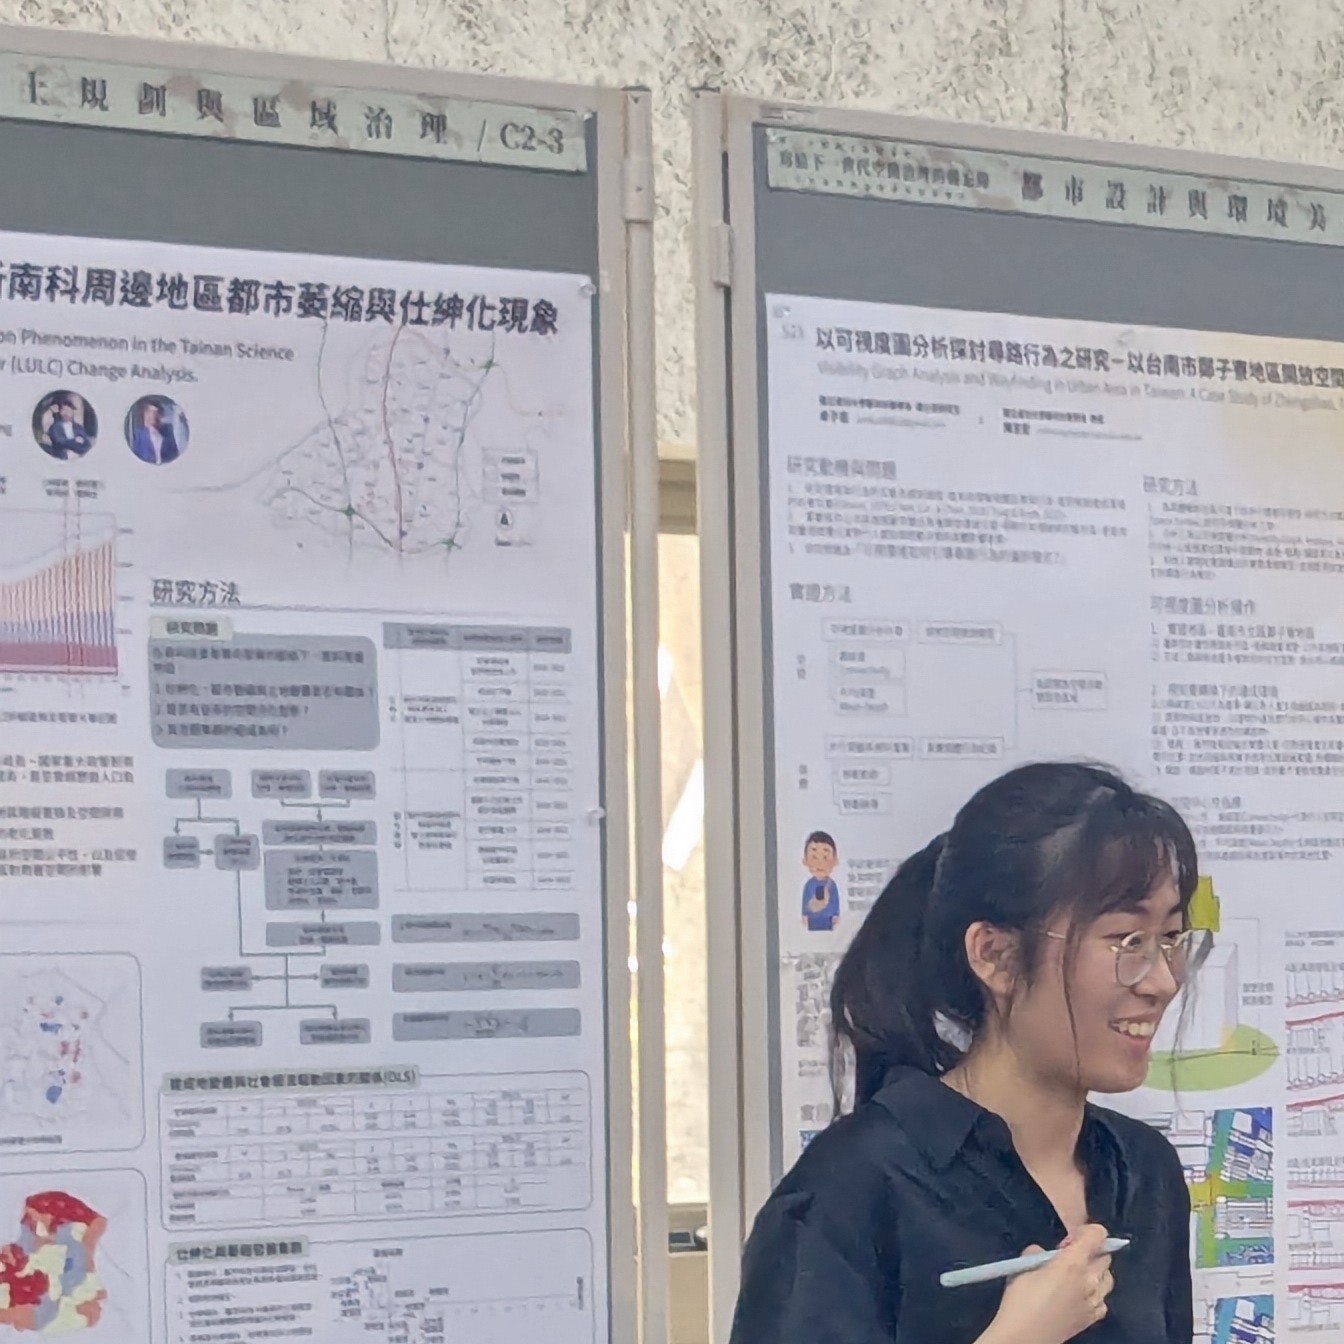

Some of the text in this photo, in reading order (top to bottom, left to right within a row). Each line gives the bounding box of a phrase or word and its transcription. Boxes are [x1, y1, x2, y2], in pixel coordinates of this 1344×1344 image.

[501, 122, 565, 154] C2-3
[0, 262, 558, 335] 南科周邊地區都市萎縮與仕紳化現象
[21, 329, 129, 351] Phenomenon
[132, 336, 147, 352] in
[152, 337, 176, 354] the
[180, 339, 232, 357] Tainan
[236, 342, 294, 362] Science
[12, 355, 63, 375] (LULC)
[67, 359, 127, 382] Change
[131, 364, 199, 384] Analysis.
[152, 578, 241, 606] 研究方法
